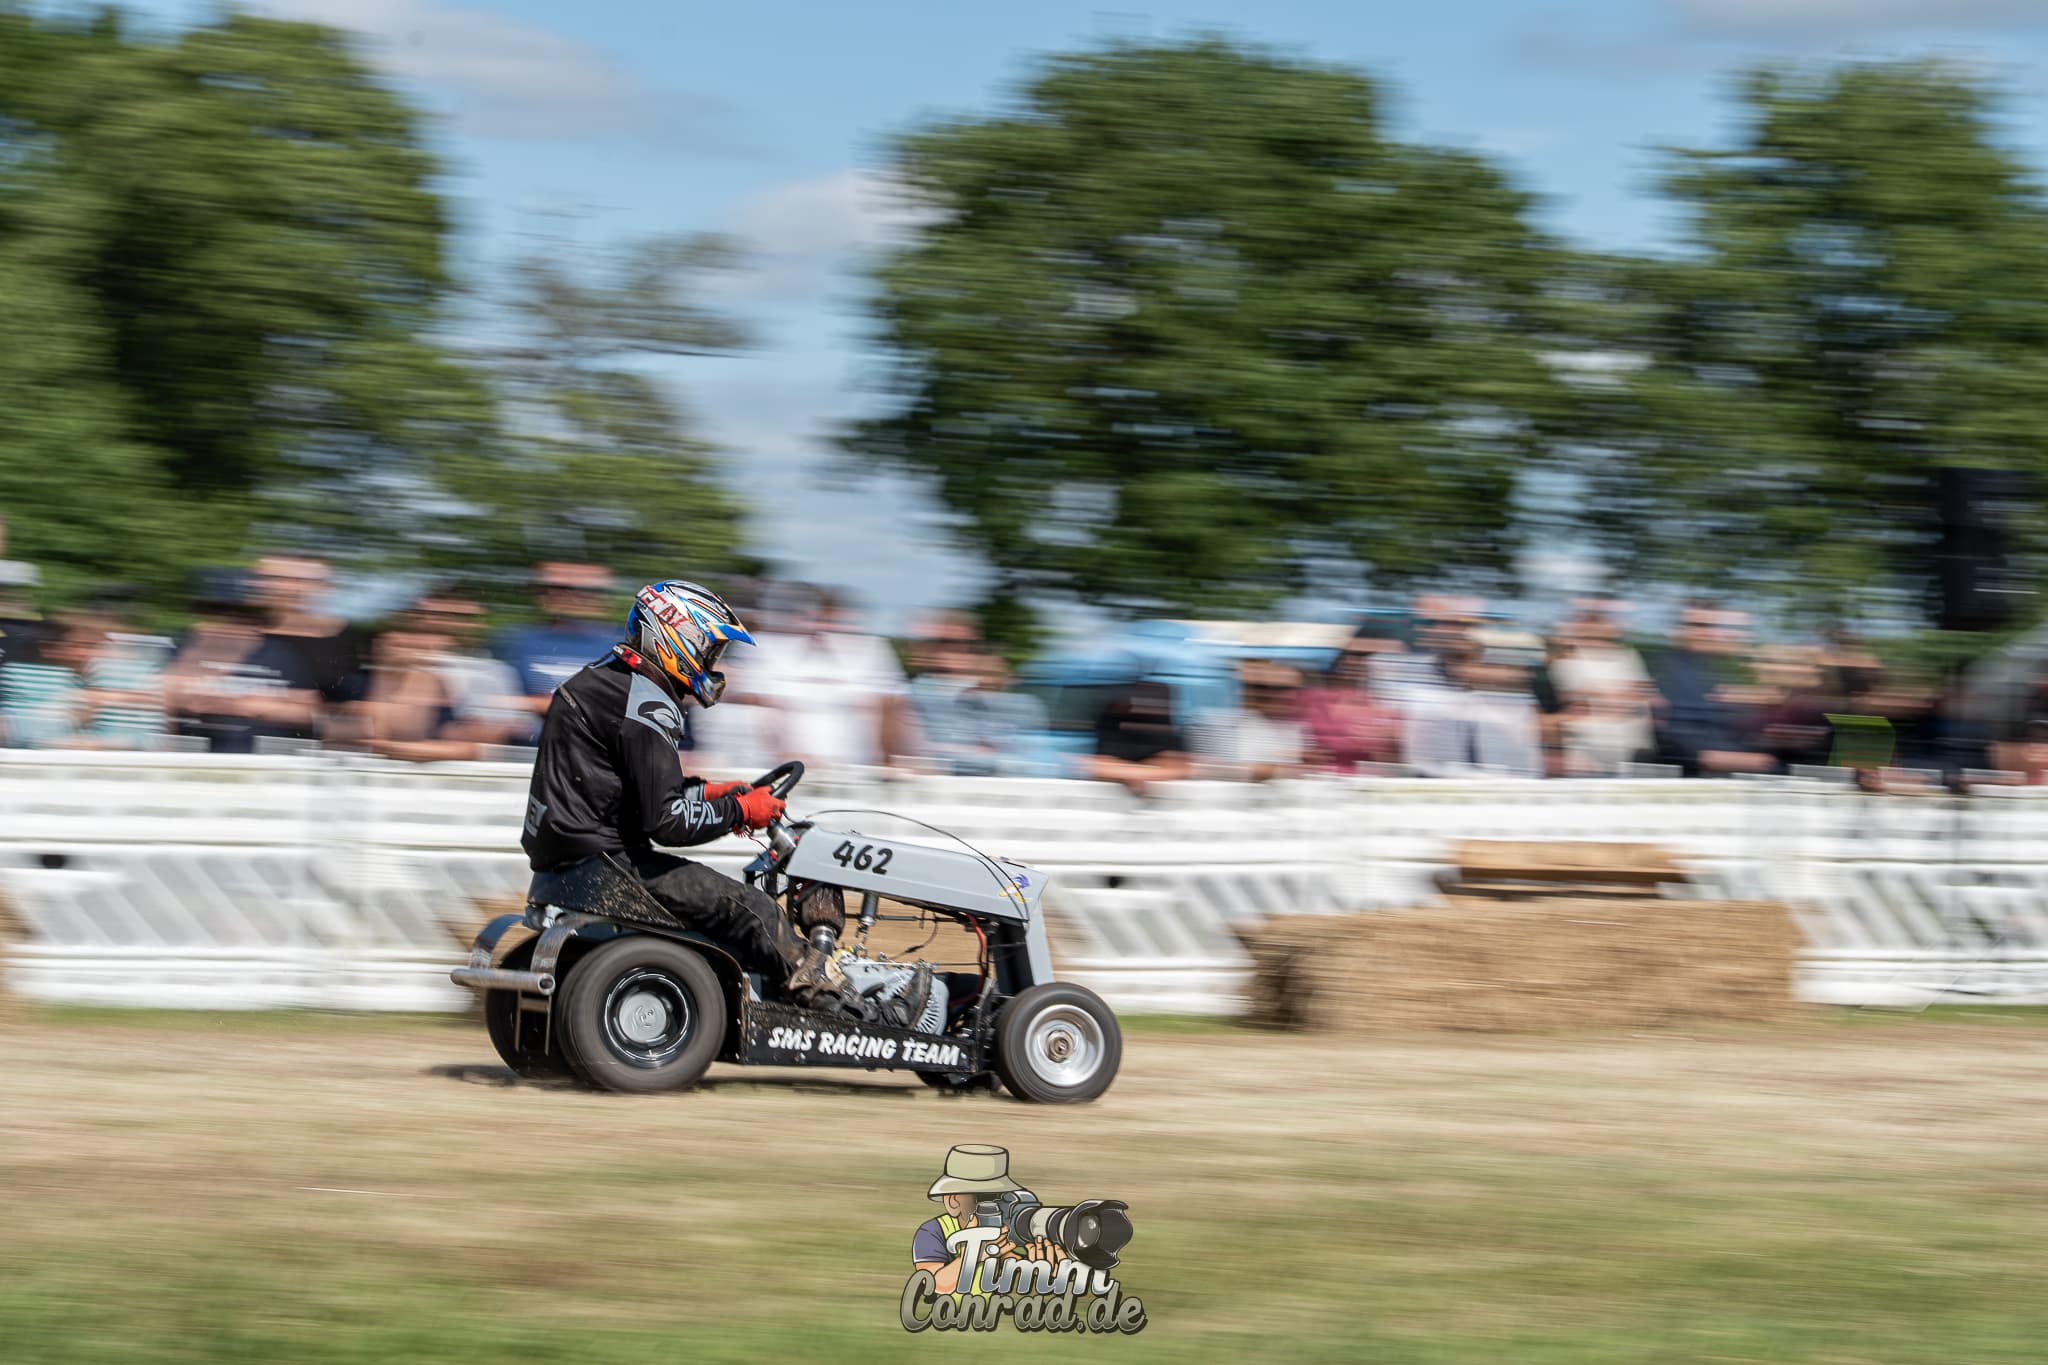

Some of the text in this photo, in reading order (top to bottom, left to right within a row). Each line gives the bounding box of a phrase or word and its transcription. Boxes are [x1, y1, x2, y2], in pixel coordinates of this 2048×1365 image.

[832, 840, 893, 875] 462
[768, 1026, 960, 1066] SMS RACING TEAM
